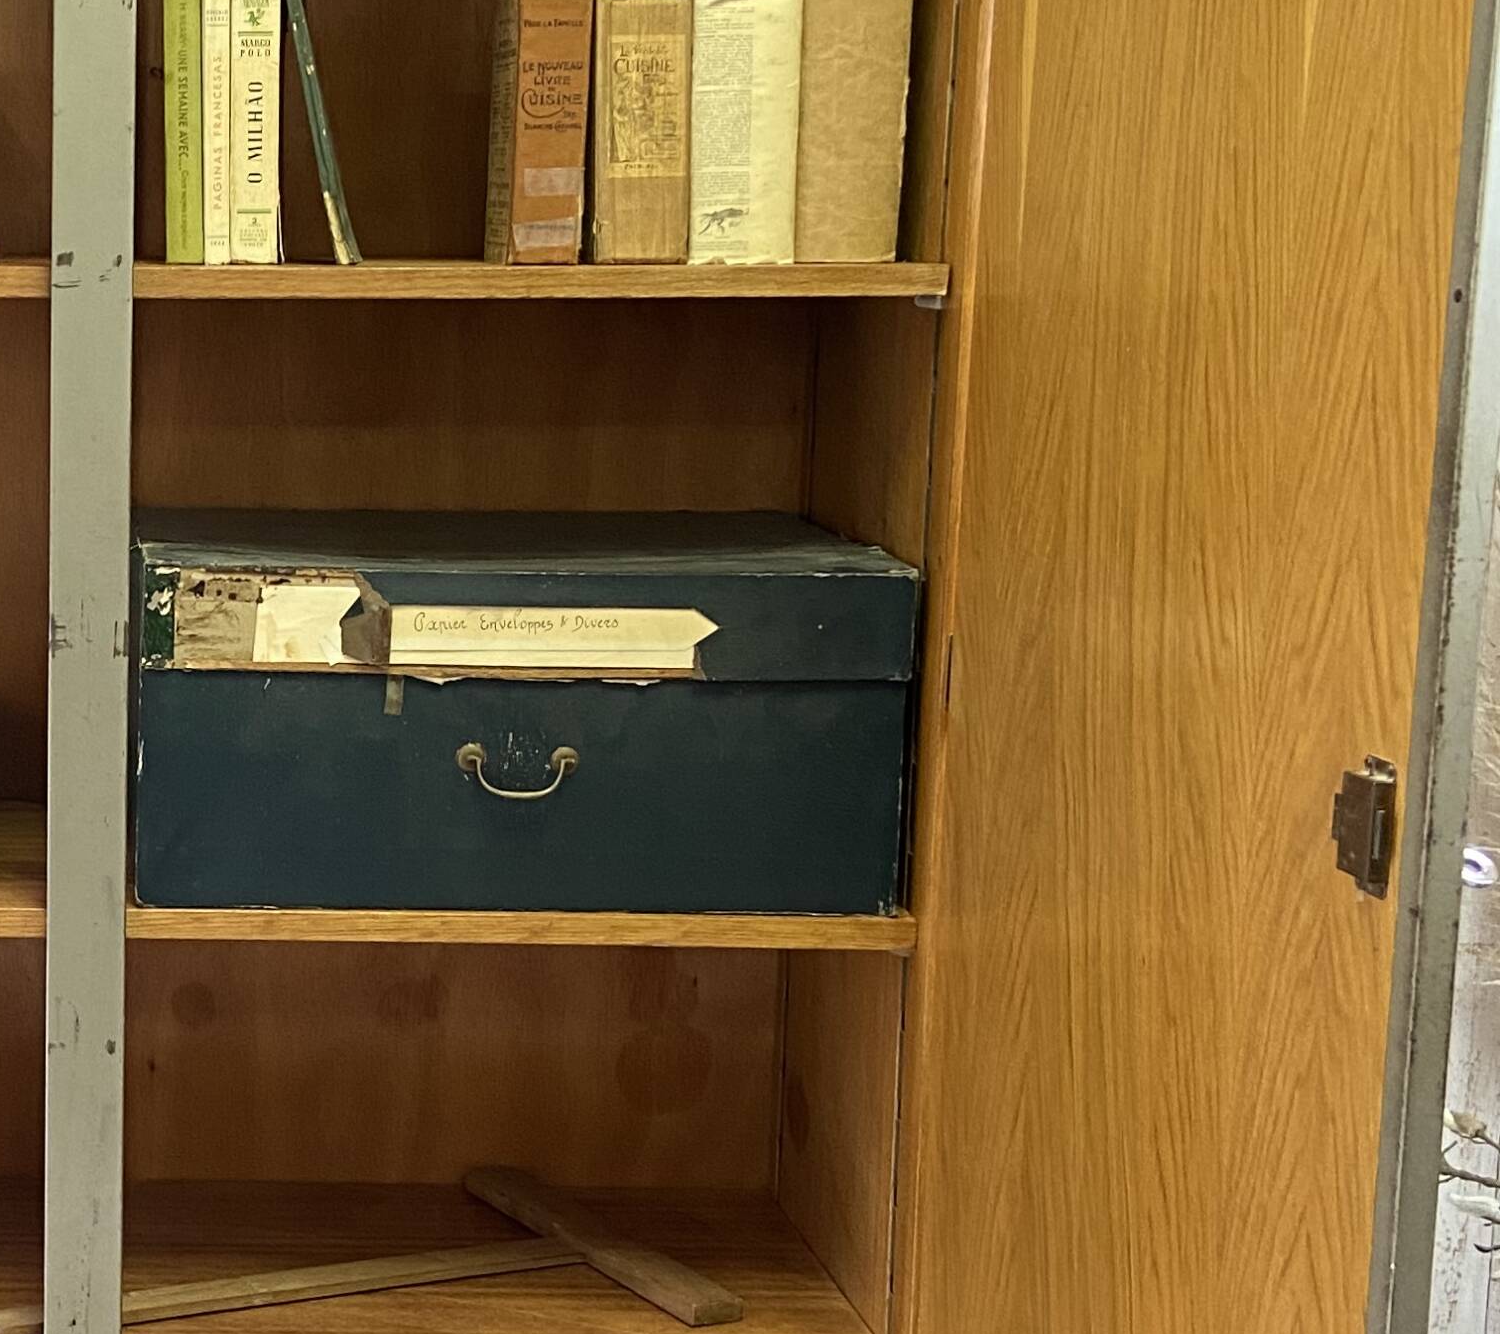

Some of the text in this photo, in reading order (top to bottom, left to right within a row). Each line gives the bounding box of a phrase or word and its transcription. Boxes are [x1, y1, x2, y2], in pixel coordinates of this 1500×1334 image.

[240, 38, 271, 48] MARCO
[240, 49, 271, 58] POLO
[177, 49, 189, 72] UNE
[522, 60, 584, 75] LE NOUVEAU
[613, 57, 676, 75] CUISINE
[177, 75, 189, 127] SEMAINE
[212, 56, 223, 210] PAGINAS FRANCESAS
[245, 81, 264, 184] O MILHÃO
[479, 608, 555, 635] Enveloppes
